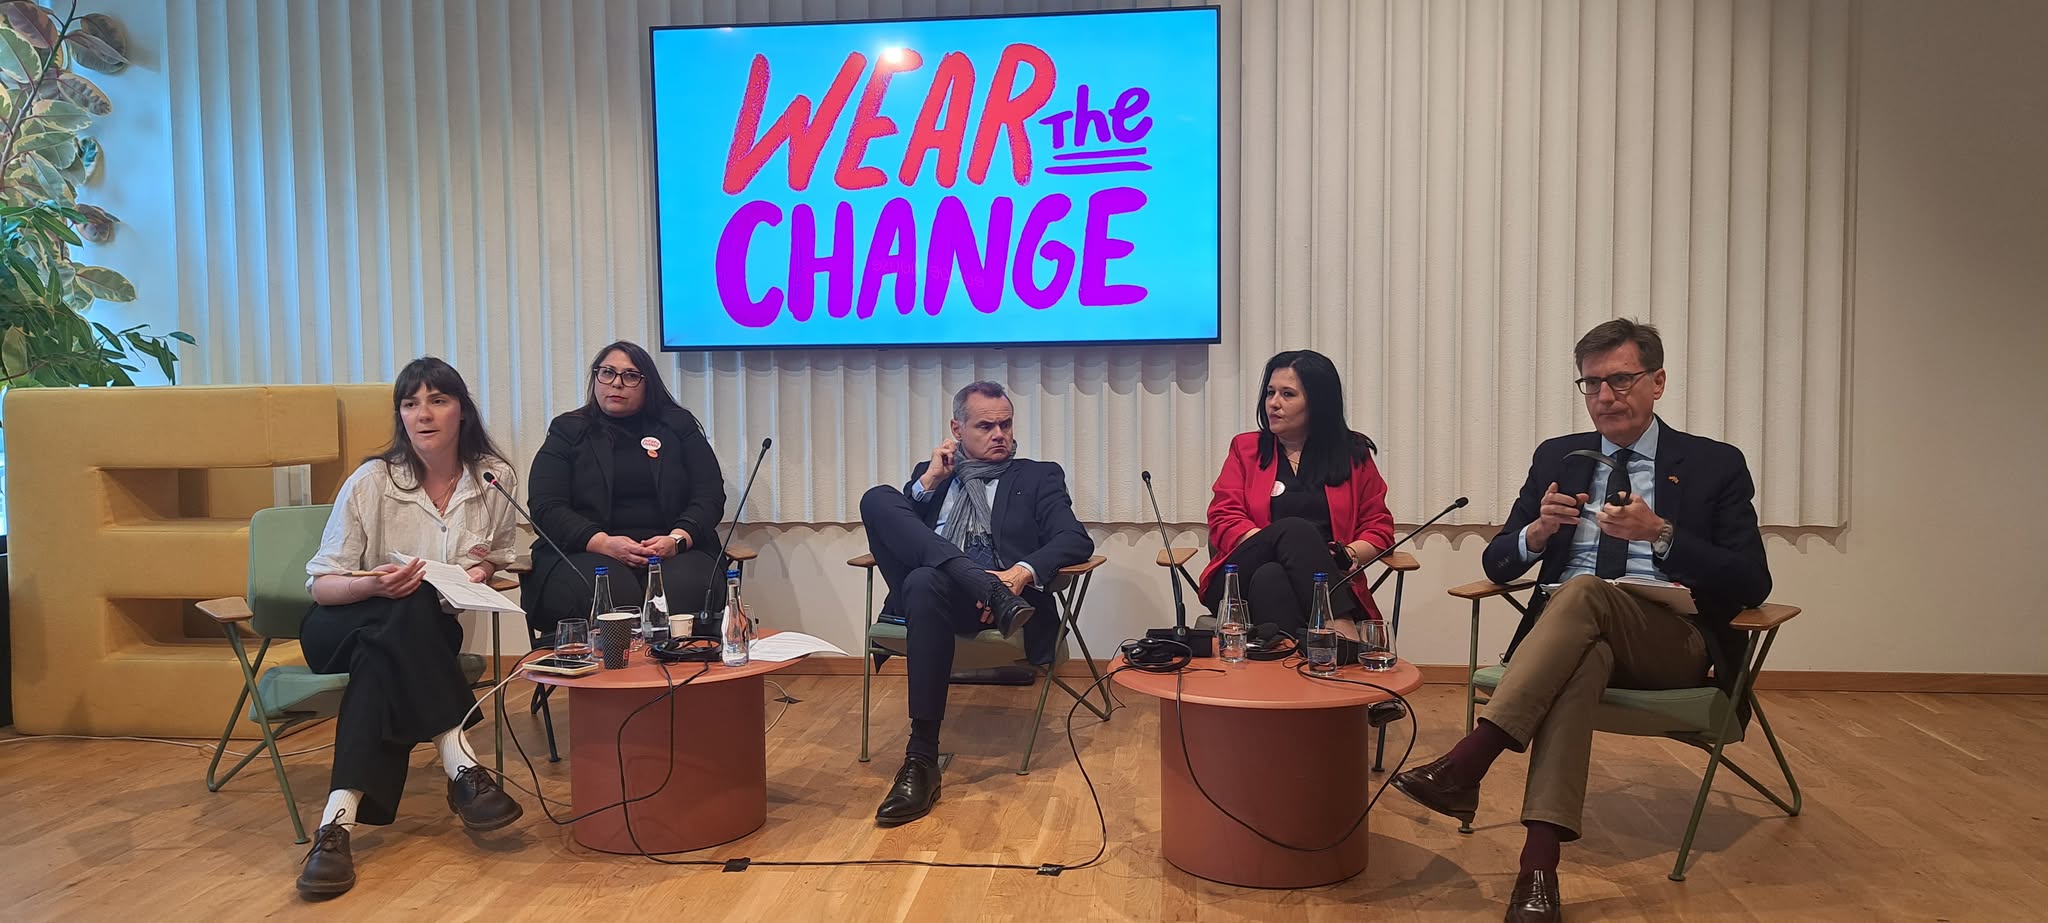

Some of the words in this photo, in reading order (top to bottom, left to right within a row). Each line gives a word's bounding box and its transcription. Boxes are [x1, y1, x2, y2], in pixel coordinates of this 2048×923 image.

[722, 43, 1057, 195] WEAR
[1040, 85, 1153, 149] The
[715, 187, 1148, 328] CHANGE
